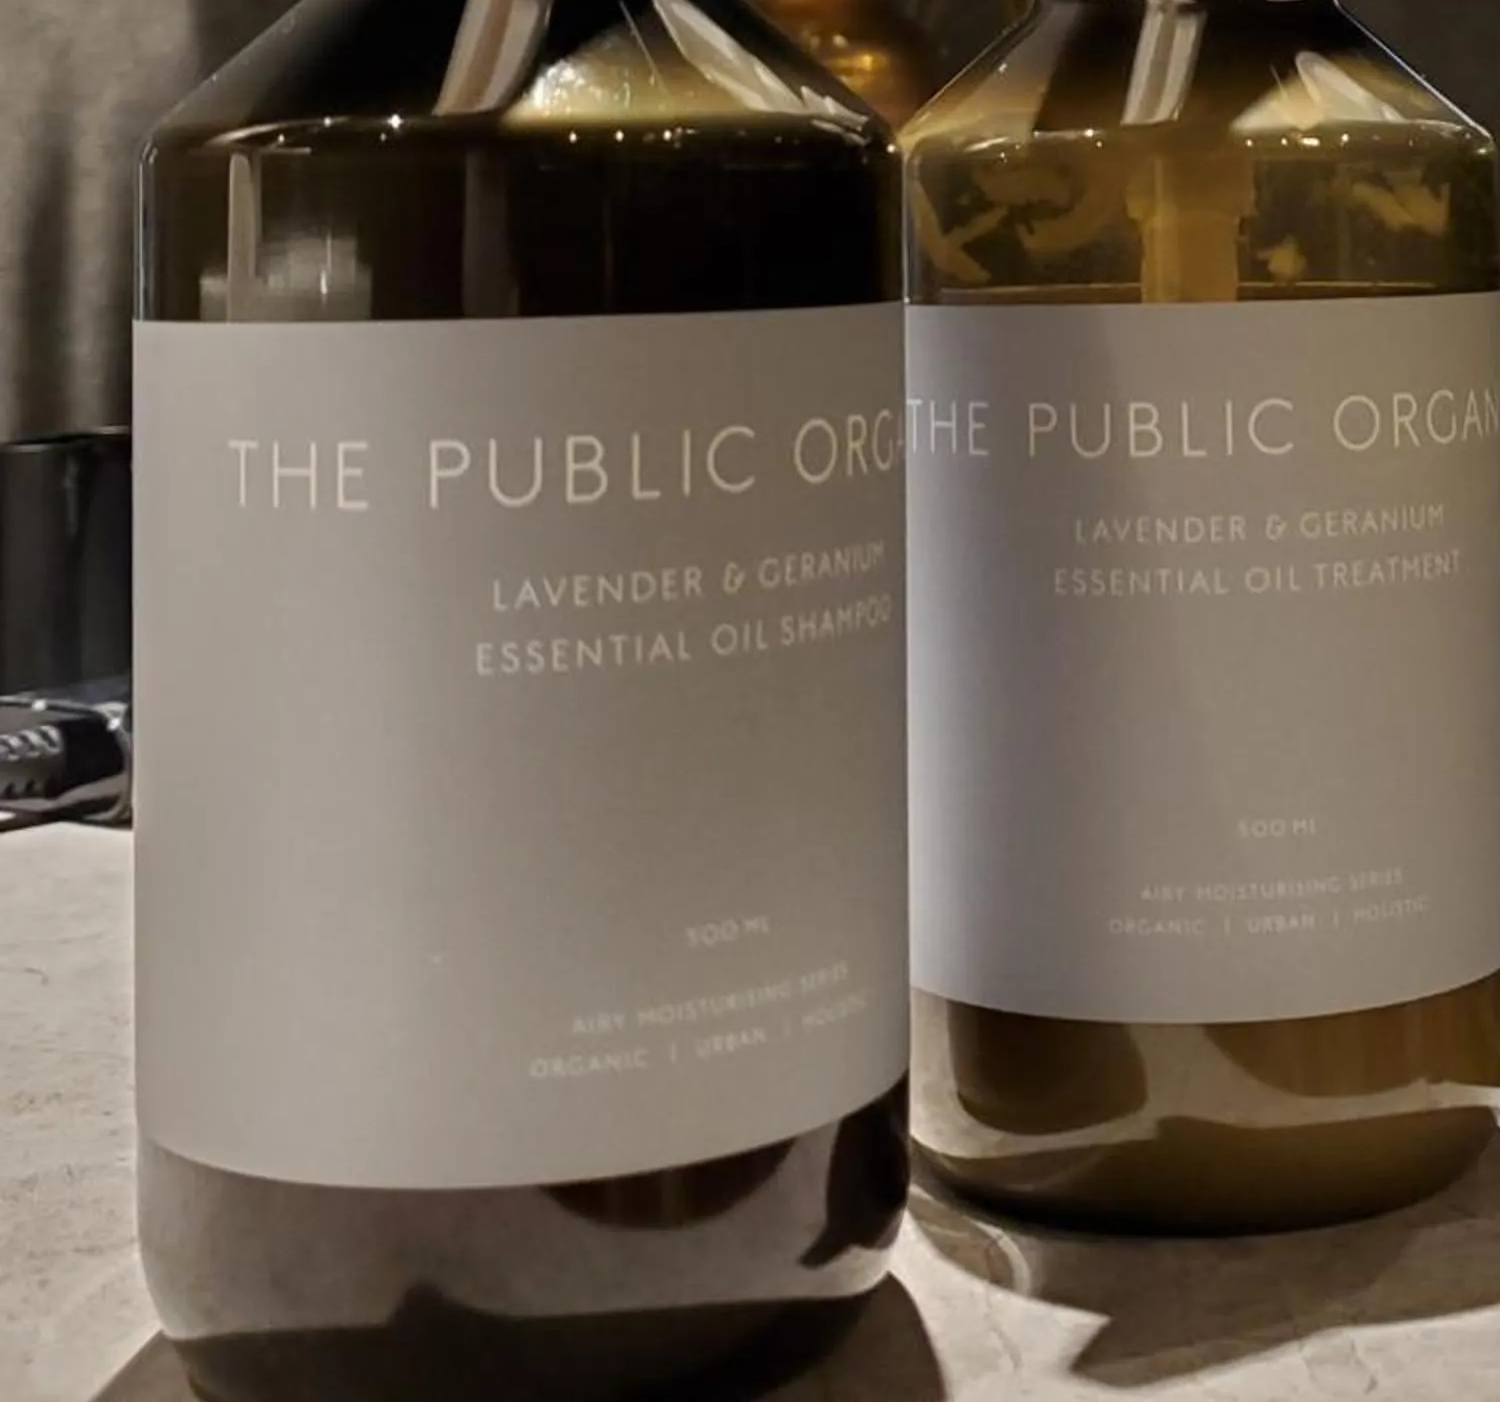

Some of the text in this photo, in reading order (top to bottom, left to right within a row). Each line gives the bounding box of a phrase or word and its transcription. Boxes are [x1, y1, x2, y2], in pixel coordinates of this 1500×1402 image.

[906, 388, 1498, 458] THE PUBLIC ORGAN
[229, 440, 368, 511] THE
[429, 426, 756, 508] PUBLIC
[1075, 503, 1445, 544] LAVENDER & GERANIUM
[492, 540, 885, 612] LAVENDER & GERANIUM
[1053, 549, 1461, 596] ESSENTIAL OIL TREATMENT
[476, 596, 892, 676] ESSENTIAL OIL SHAMPOO
